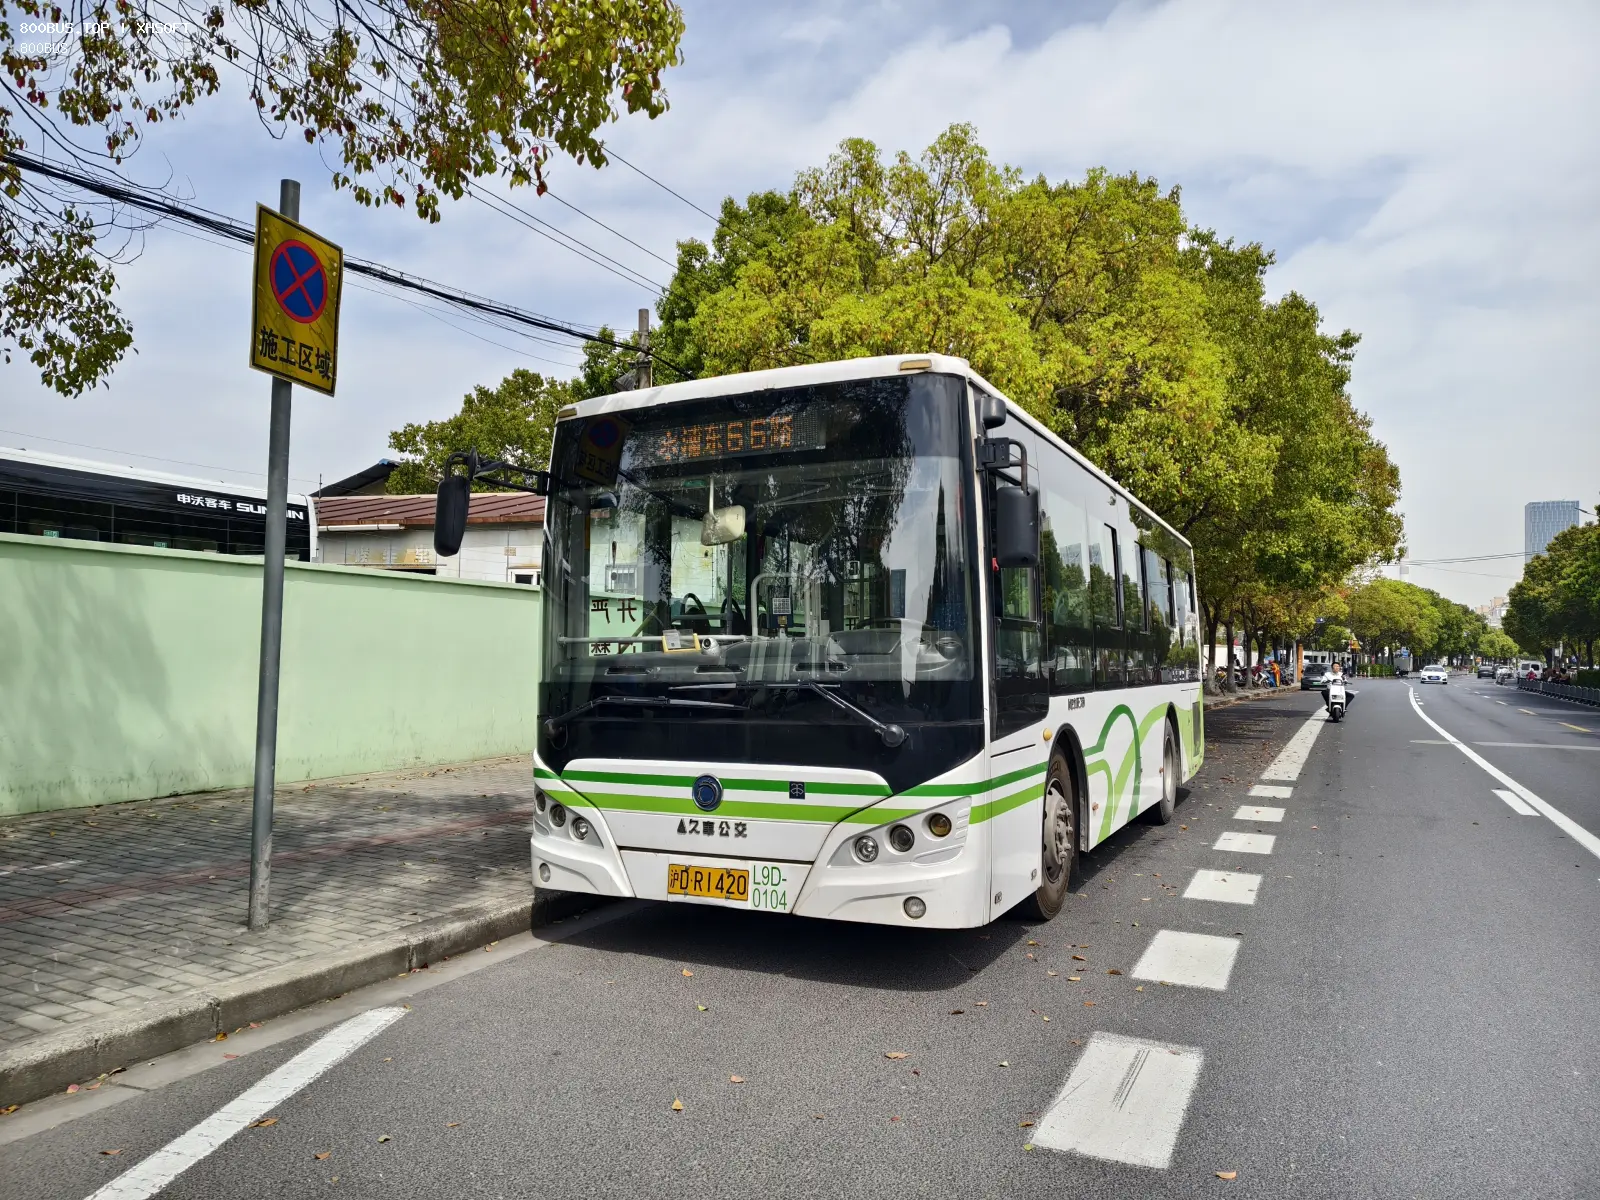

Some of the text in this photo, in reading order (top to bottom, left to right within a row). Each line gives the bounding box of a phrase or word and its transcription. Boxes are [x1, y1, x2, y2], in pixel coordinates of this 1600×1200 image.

[259, 326, 333, 380] 施工区域
[176, 493, 304, 520] 申沃客车 SUIN
[752, 864, 788, 888] L9D-
[752, 887, 788, 911] 0104
